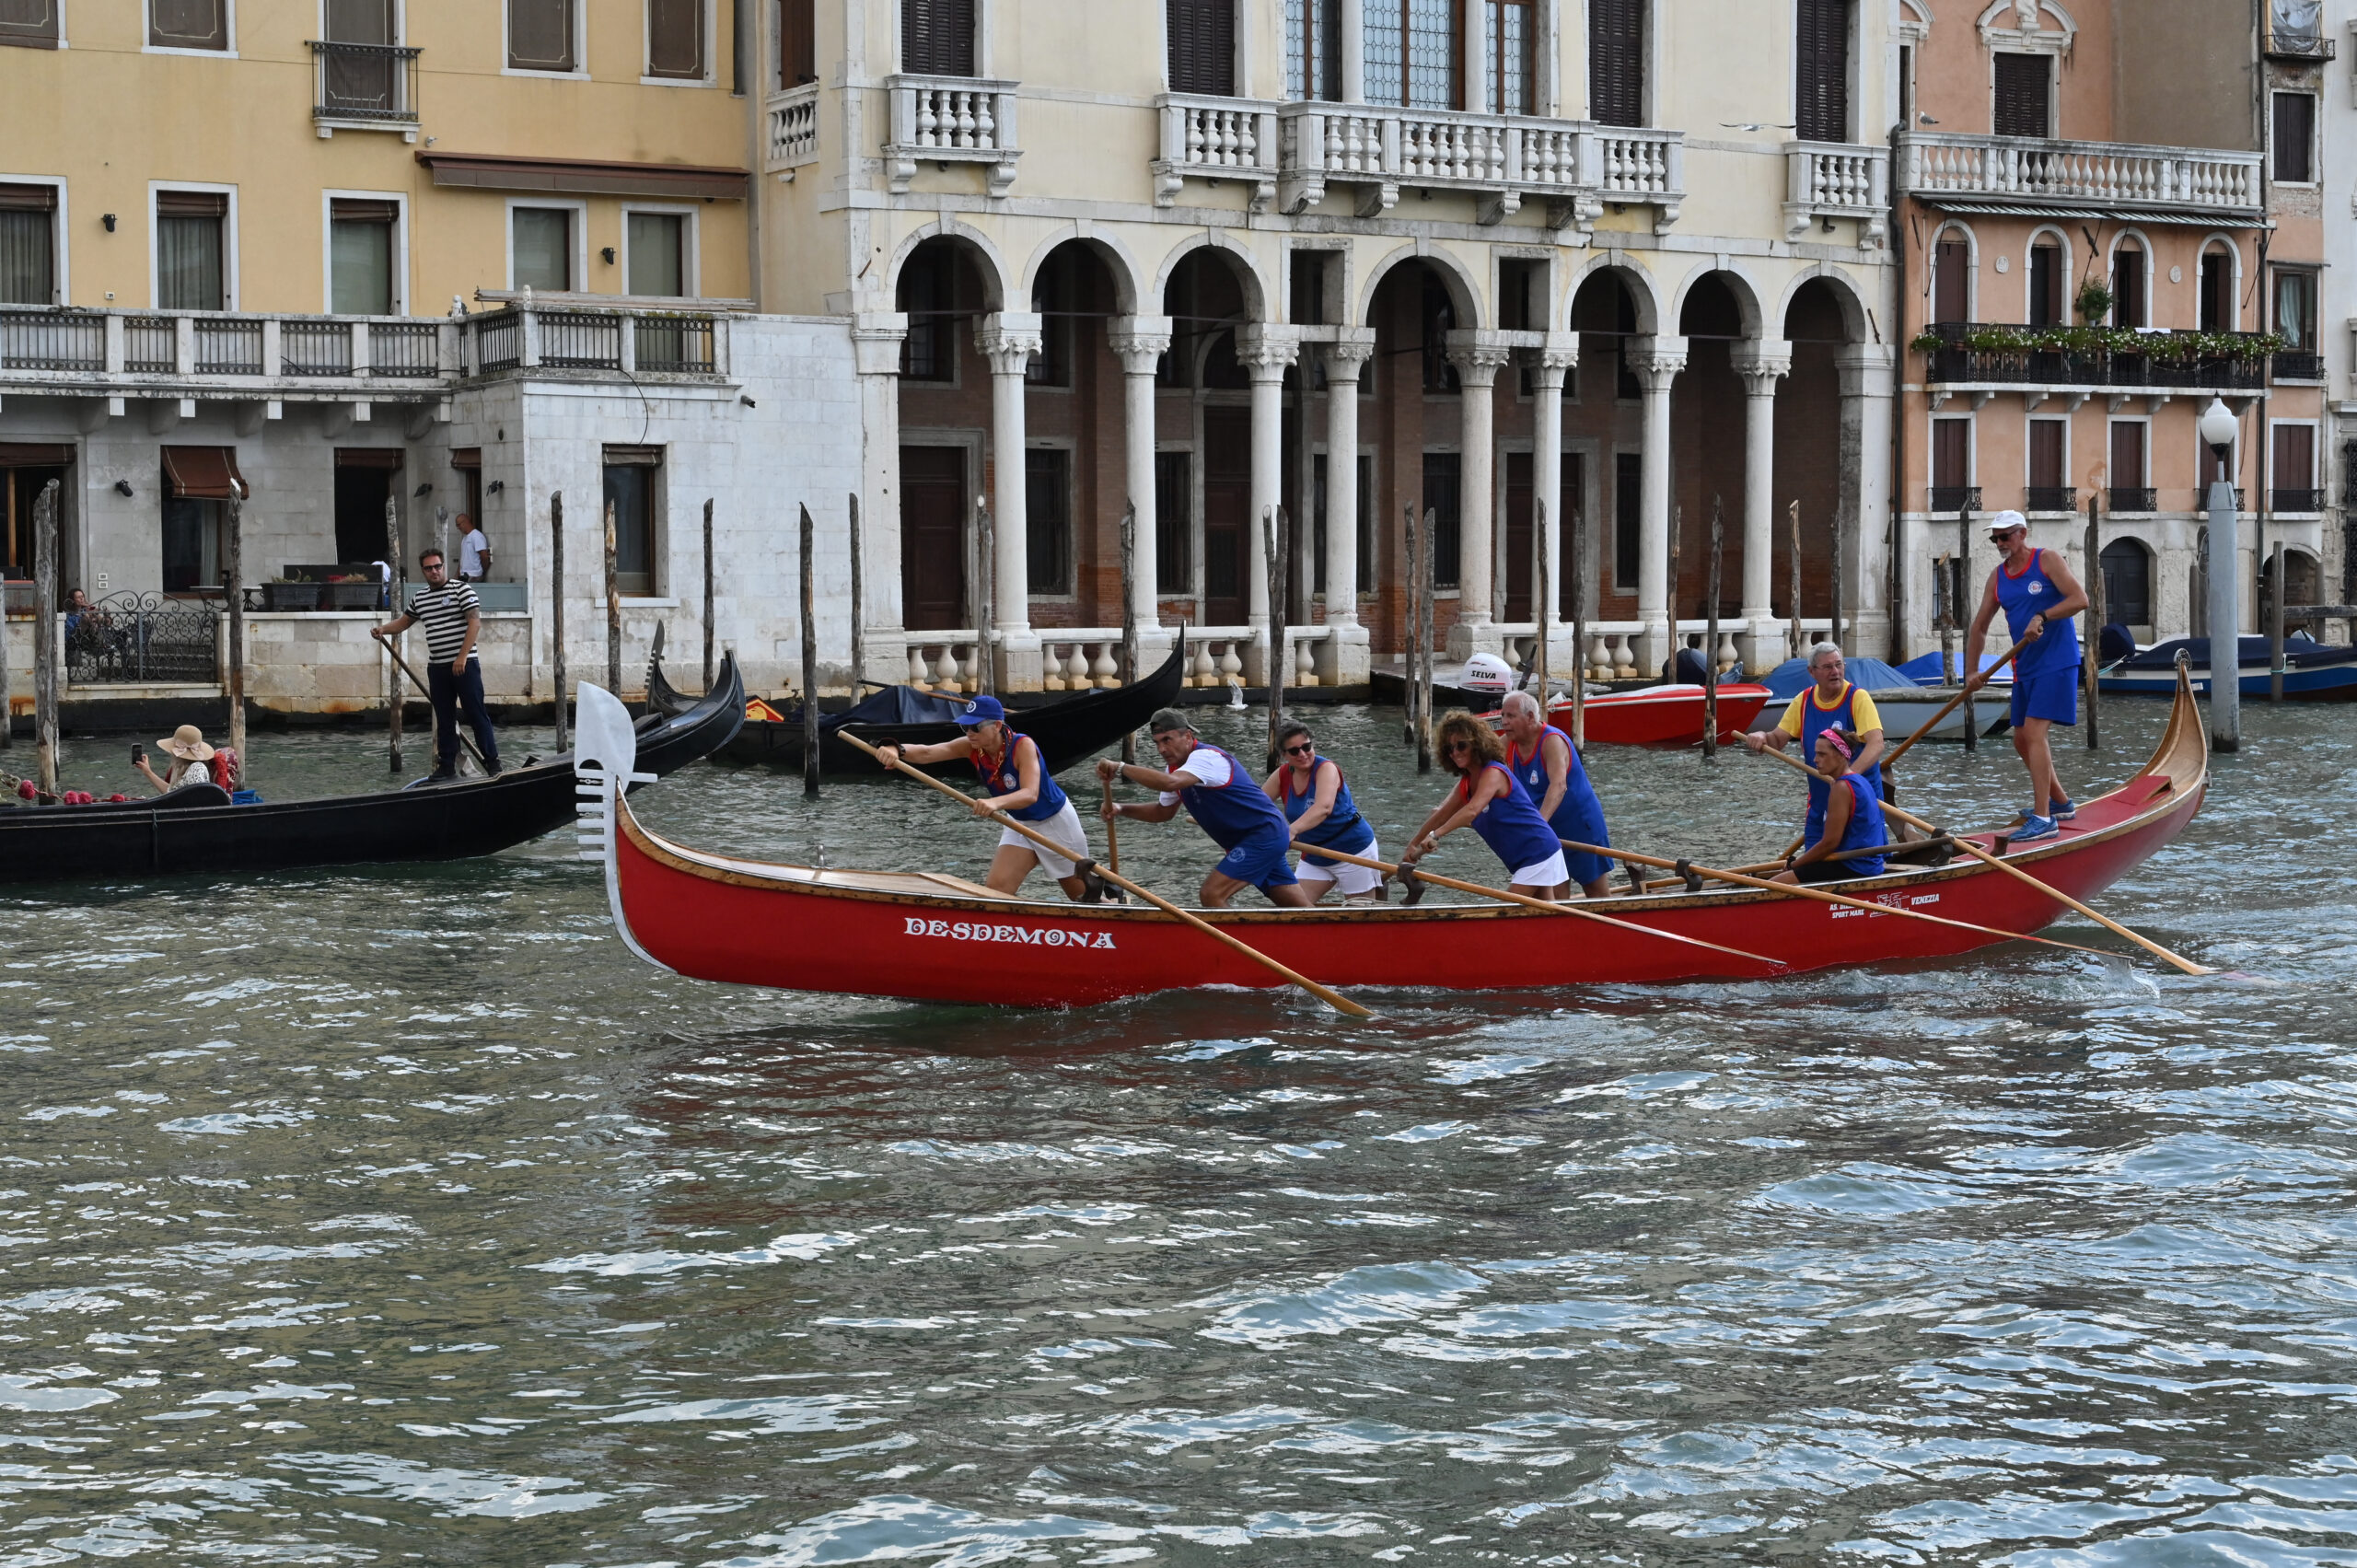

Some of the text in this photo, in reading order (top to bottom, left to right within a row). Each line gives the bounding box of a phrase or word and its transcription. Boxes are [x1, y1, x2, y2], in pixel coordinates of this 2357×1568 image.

[1471, 670, 1496, 679] SELVA
[1911, 893, 1940, 905] VENEZIA
[1832, 909, 1864, 919] SPORT MARE
[904, 917, 1117, 949] DESDEMONA
